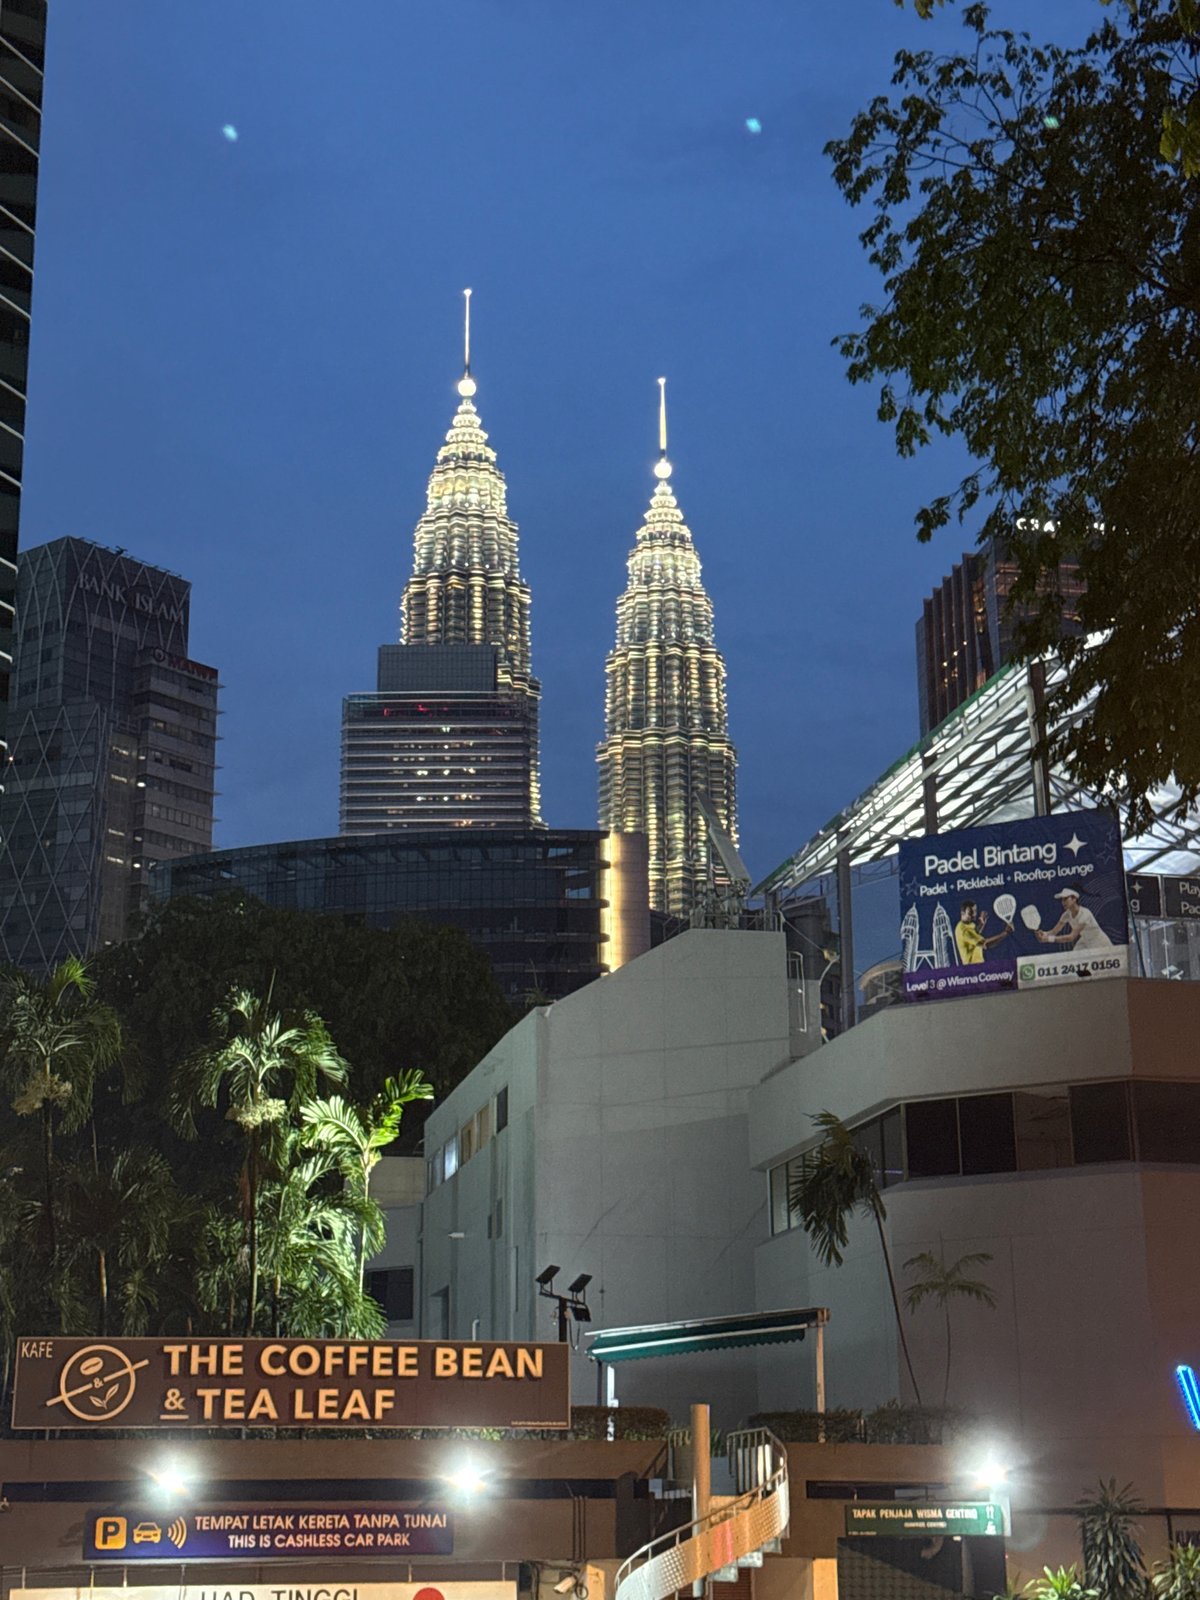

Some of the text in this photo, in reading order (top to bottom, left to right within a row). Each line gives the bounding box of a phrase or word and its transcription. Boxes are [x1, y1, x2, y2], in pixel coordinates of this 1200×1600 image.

[79, 571, 184, 625] BANK ISLAM
[924, 842, 1057, 877] Padel Bintang
[919, 863, 1094, 897] Padel Pickleball Rooftop lounge
[1037, 966, 1058, 977] 011
[906, 980, 929, 992] Level
[929, 979, 936, 989] 3
[936, 978, 947, 990] @
[947, 975, 978, 987] Wisma
[21, 1341, 53, 1359] KAFE
[163, 1344, 544, 1378] THE COFFEE BEAN
[163, 1388, 396, 1420] & TEA LEAF
[195, 1513, 447, 1531] TEMPAT LETAK KERETA TANPA TUNAI
[852, 1508, 877, 1519] TAPAK
[228, 1533, 411, 1549] THIS IS CASHLESS CAR PARK
